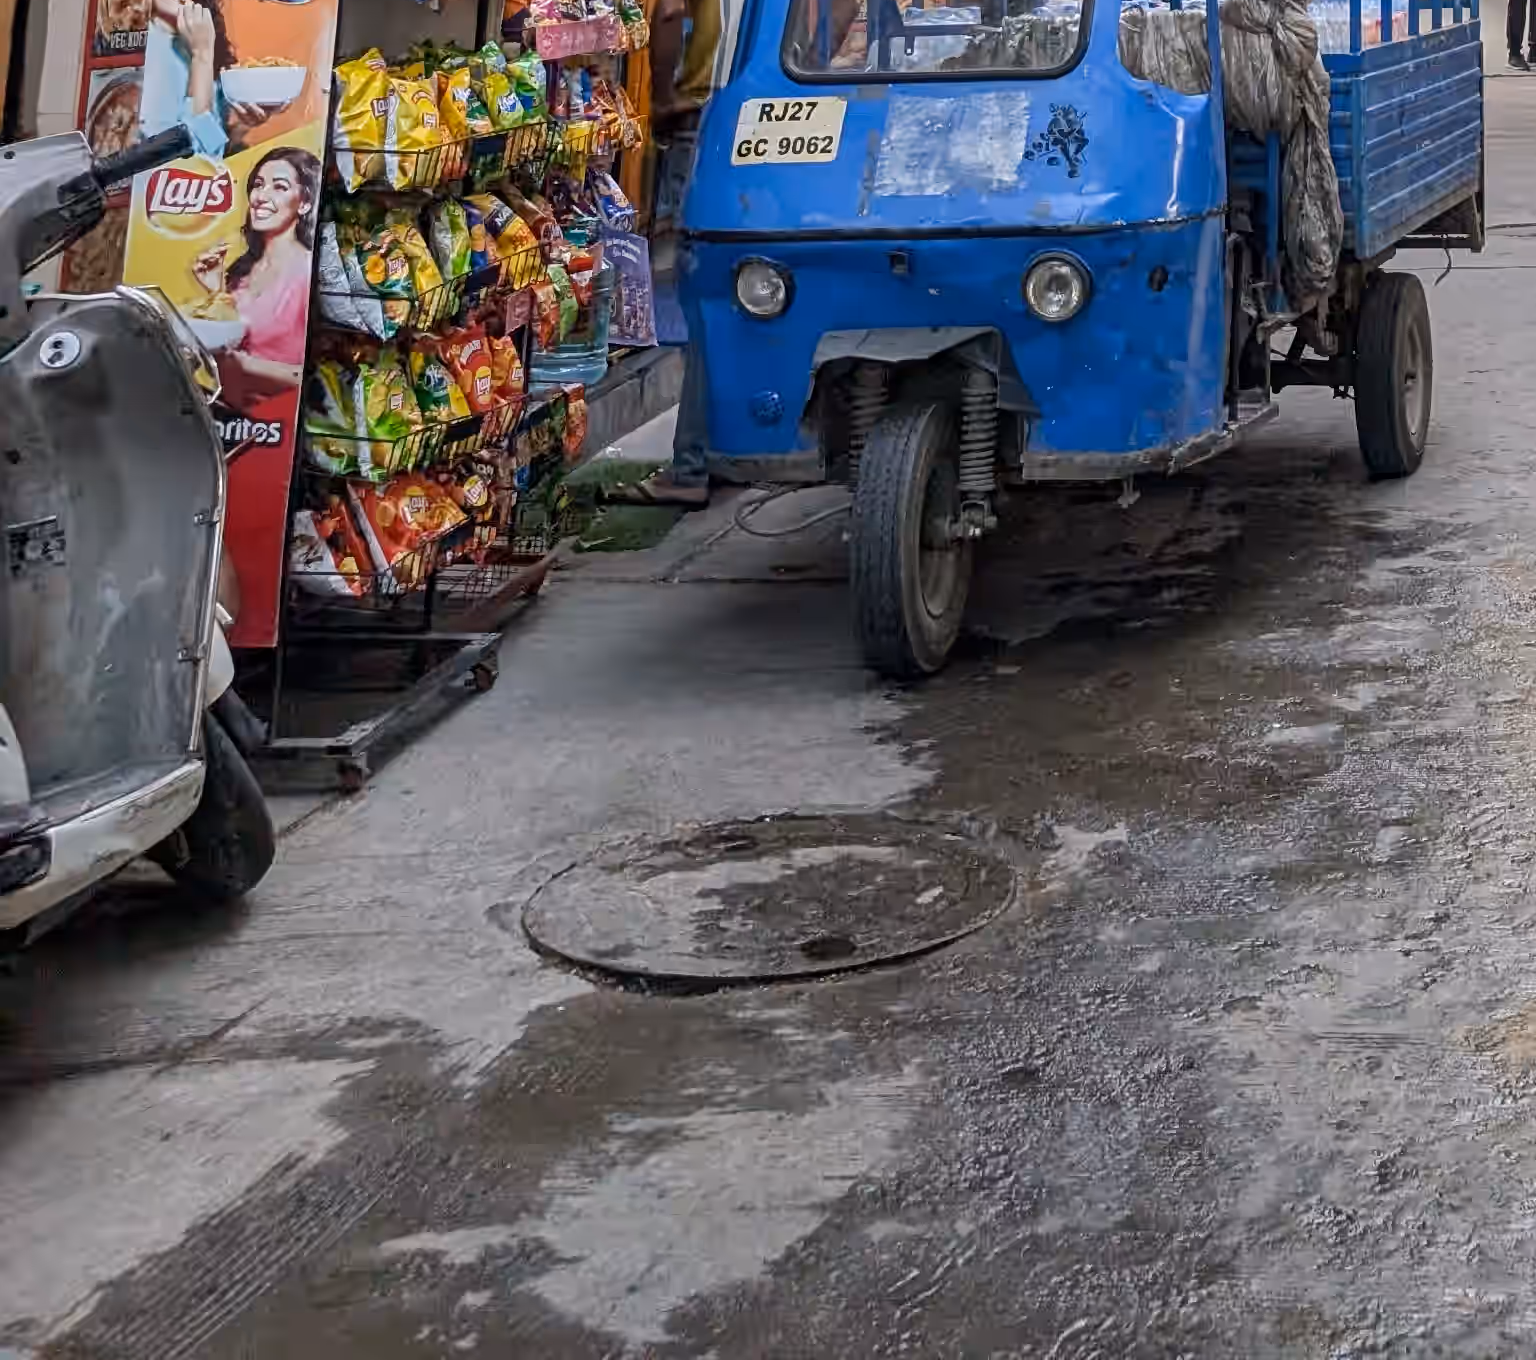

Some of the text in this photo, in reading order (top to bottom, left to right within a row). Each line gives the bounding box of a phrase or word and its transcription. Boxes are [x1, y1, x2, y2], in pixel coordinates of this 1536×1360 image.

[110, 31, 126, 49] VEG
[758, 102, 819, 124] RJ27
[736, 135, 834, 158] GC 9062
[150, 170, 233, 215] Lay's
[214, 417, 281, 444] oritos
